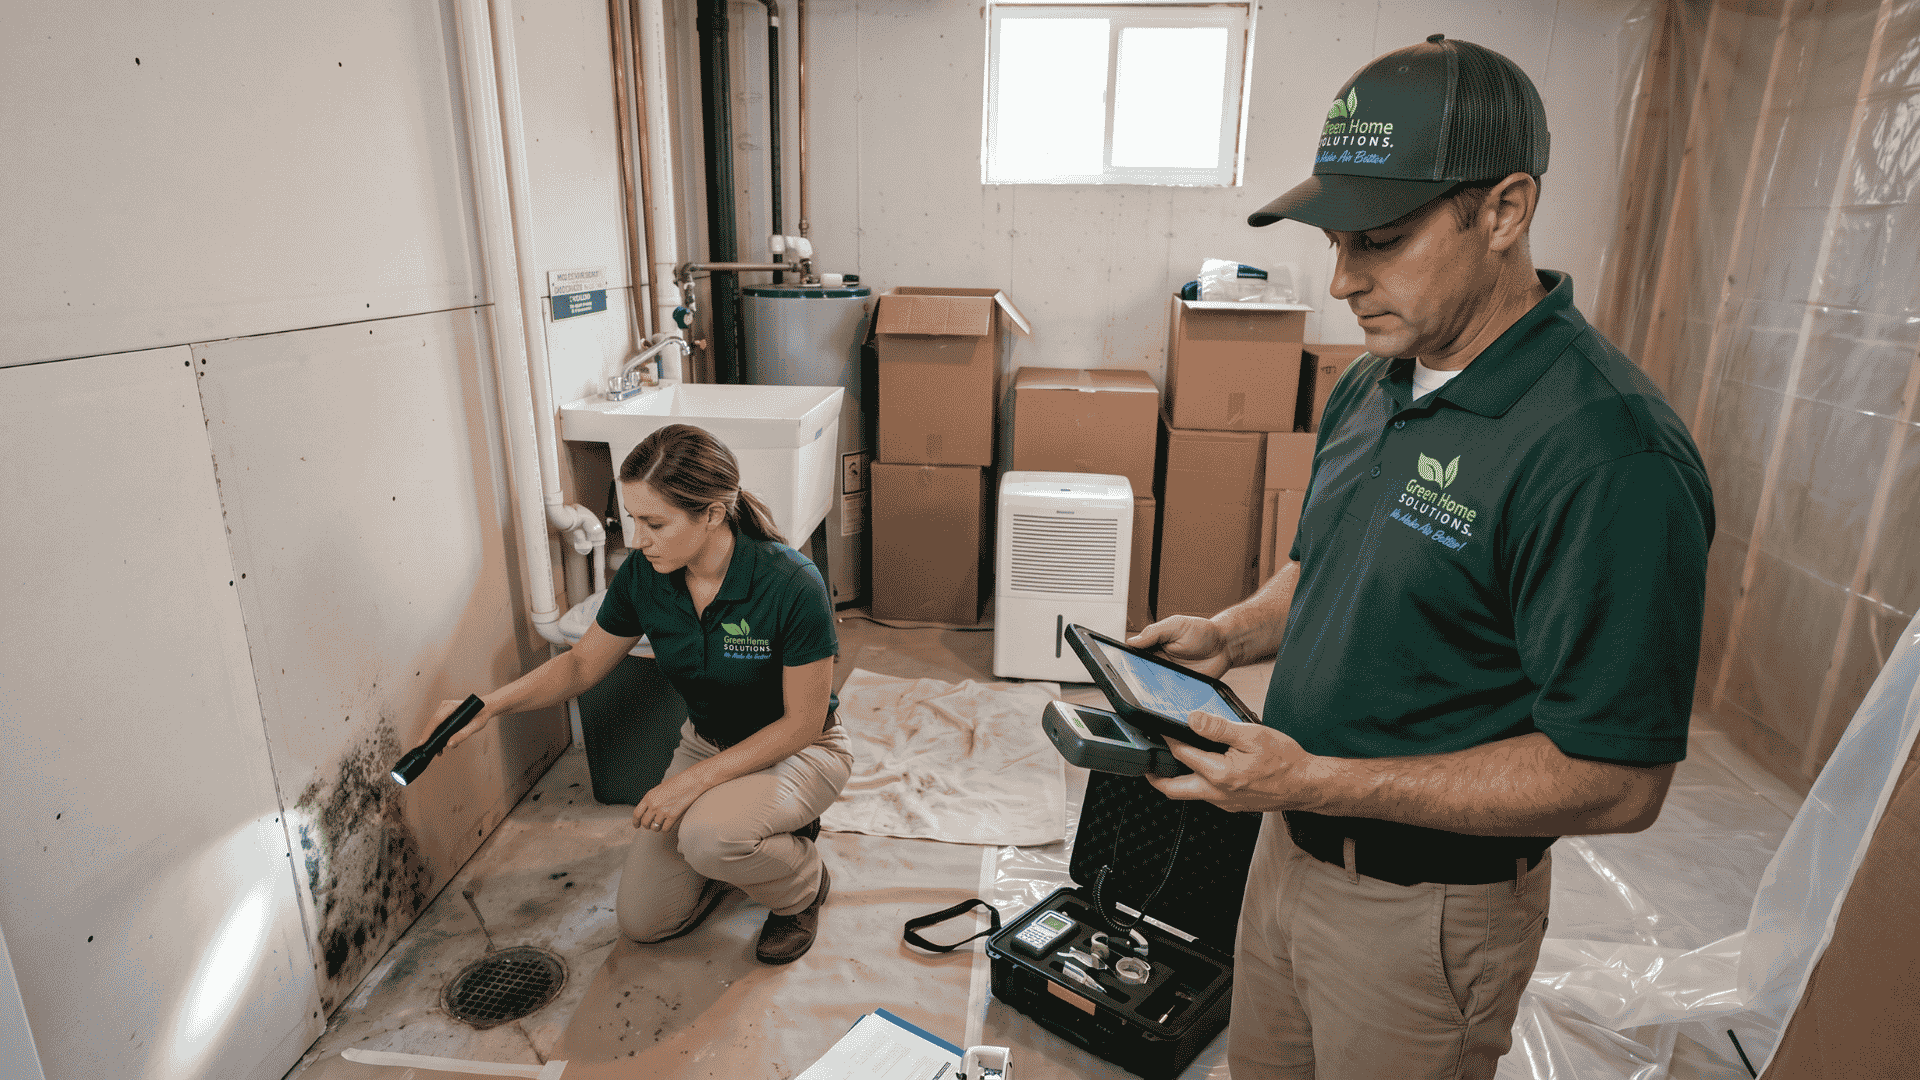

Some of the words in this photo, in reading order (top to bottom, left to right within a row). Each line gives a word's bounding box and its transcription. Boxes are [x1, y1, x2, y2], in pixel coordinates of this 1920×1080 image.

[1349, 119, 1393, 135] Home
[1319, 136, 1394, 148] OLUTIONS.
[1406, 479, 1438, 503] Green
[1437, 493, 1476, 522] Home
[1399, 493, 1472, 536] SOLUTIONS.
[724, 635, 746, 645] Green
[746, 636, 769, 646] Home
